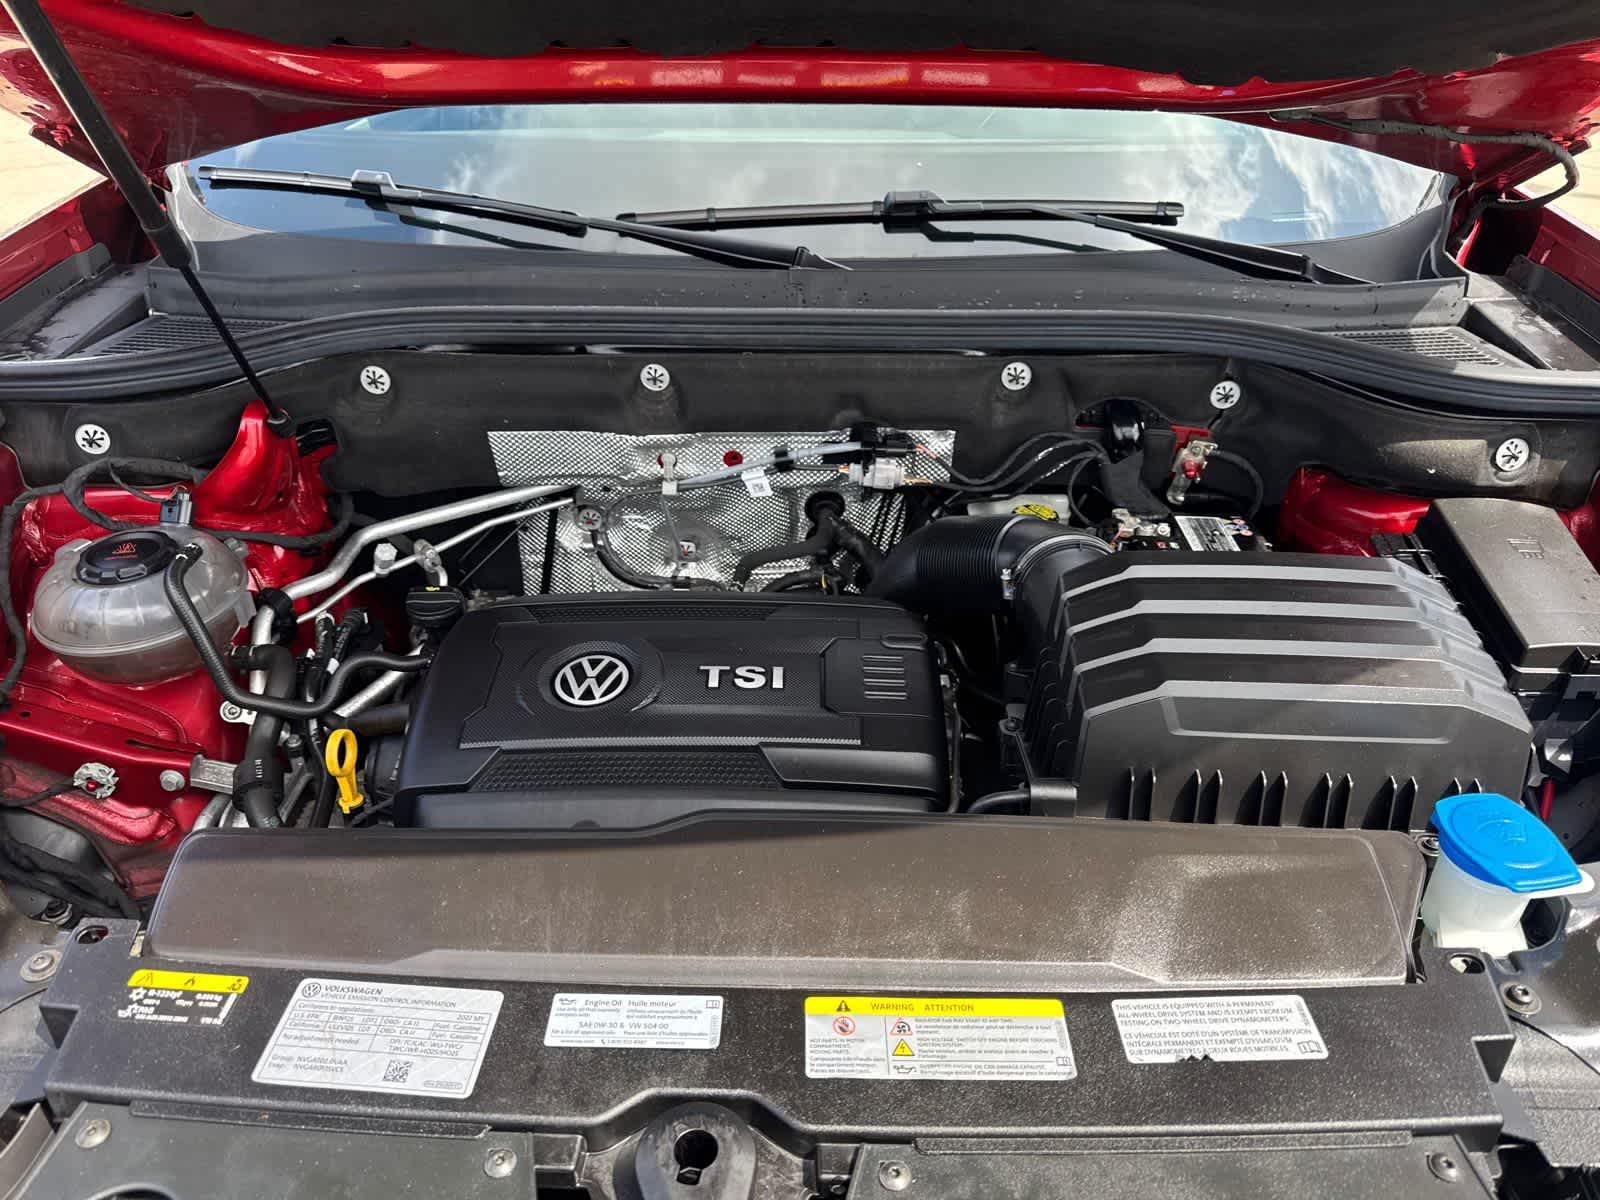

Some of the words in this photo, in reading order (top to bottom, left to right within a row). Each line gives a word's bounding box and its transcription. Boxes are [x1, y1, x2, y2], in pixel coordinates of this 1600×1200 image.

[700, 665, 784, 689] TSI
[325, 984, 383, 995] VOLKSWAGEN
[321, 992, 346, 1000] VEHICLE
[379, 996, 409, 1004] CONTROL
[409, 998, 458, 1008] INFORMATION
[584, 999, 610, 1008] Engine
[611, 999, 623, 1007] Oil
[1170, 1002, 1206, 1010] EQUIPPED
[1207, 1001, 1225, 1009] WITH
[1232, 1000, 1275, 1008] PERMANENT
[871, 1002, 914, 1011] WARNING
[924, 1003, 974, 1012] ATTENTION
[1118, 1011, 1157, 1019] ALL-WHEEL
[1133, 1031, 1168, 1039] VÉHICULE
[1163, 1039, 1204, 1047] PERMANENT
